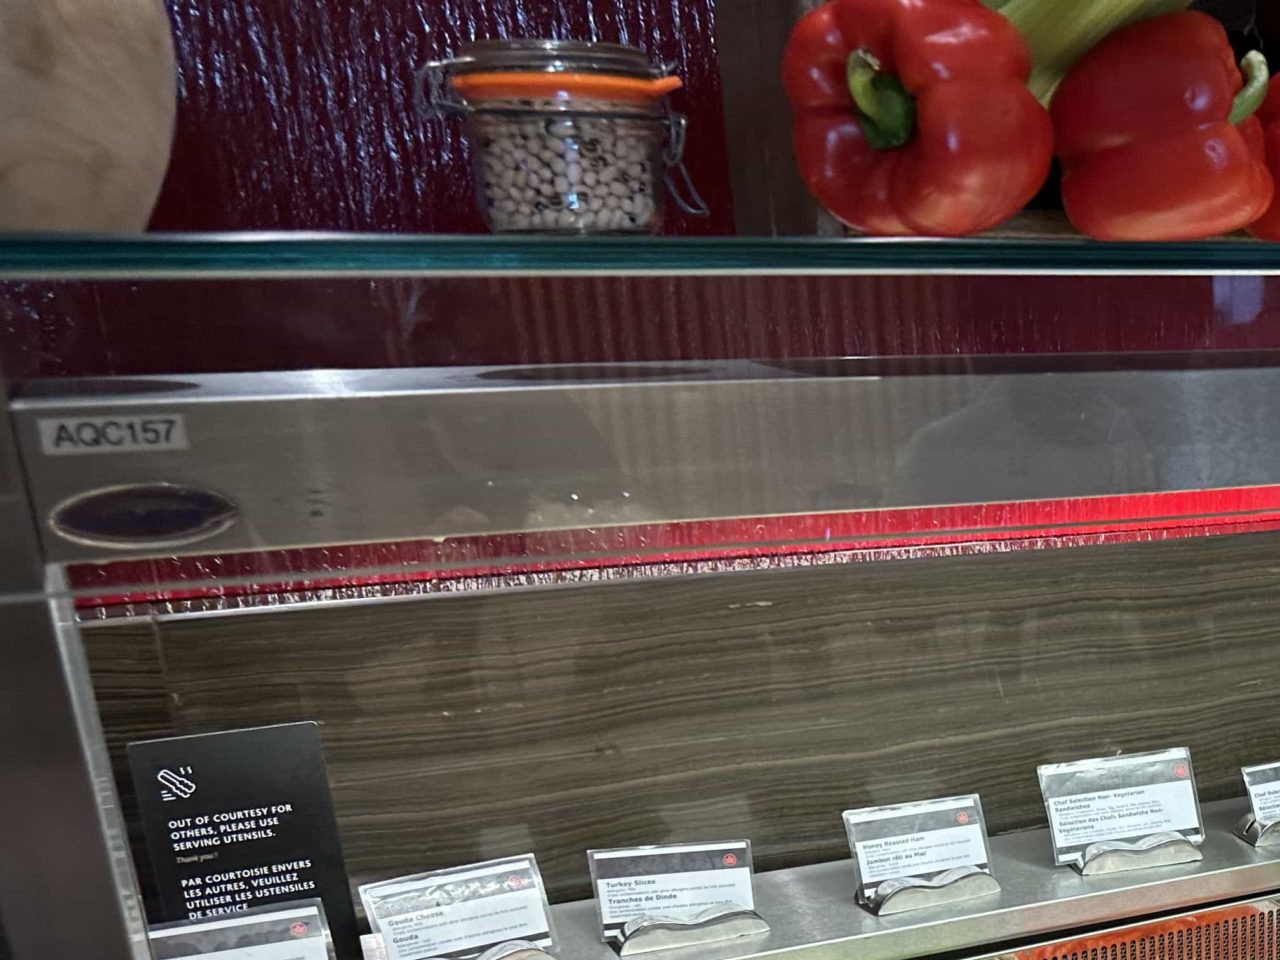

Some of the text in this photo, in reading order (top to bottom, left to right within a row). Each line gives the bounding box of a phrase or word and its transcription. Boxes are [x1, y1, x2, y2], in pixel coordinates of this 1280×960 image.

[55, 420, 175, 447] AQC157
[1069, 795, 1096, 804] Selection
[1113, 790, 1145, 799] Vegetarian
[168, 804, 292, 829] OUT OF COURTESY FOR
[1055, 804, 1090, 812] Sandwiches
[171, 817, 279, 840] OTHERS, PLEASE USE
[174, 829, 276, 851] SERVING UTENSILS.
[884, 838, 909, 846] Roasted
[176, 855, 198, 864] Thank
[866, 857, 891, 865] Jambon
[914, 850, 927, 858] Miel
[181, 860, 311, 888] PAR COURTOISIE ENVERS
[184, 873, 299, 898] LES AUTRES, VEUILLEZ
[606, 880, 632, 888] Turkey
[187, 881, 315, 909] UTILISER LES USTENSILES
[608, 896, 642, 905] Tranches
[656, 893, 677, 901] Dinde
[189, 903, 248, 920] DE SERVICE
[388, 916, 414, 927] Gouda
[416, 910, 444, 921] Cheese
[393, 933, 419, 944] Gouda
